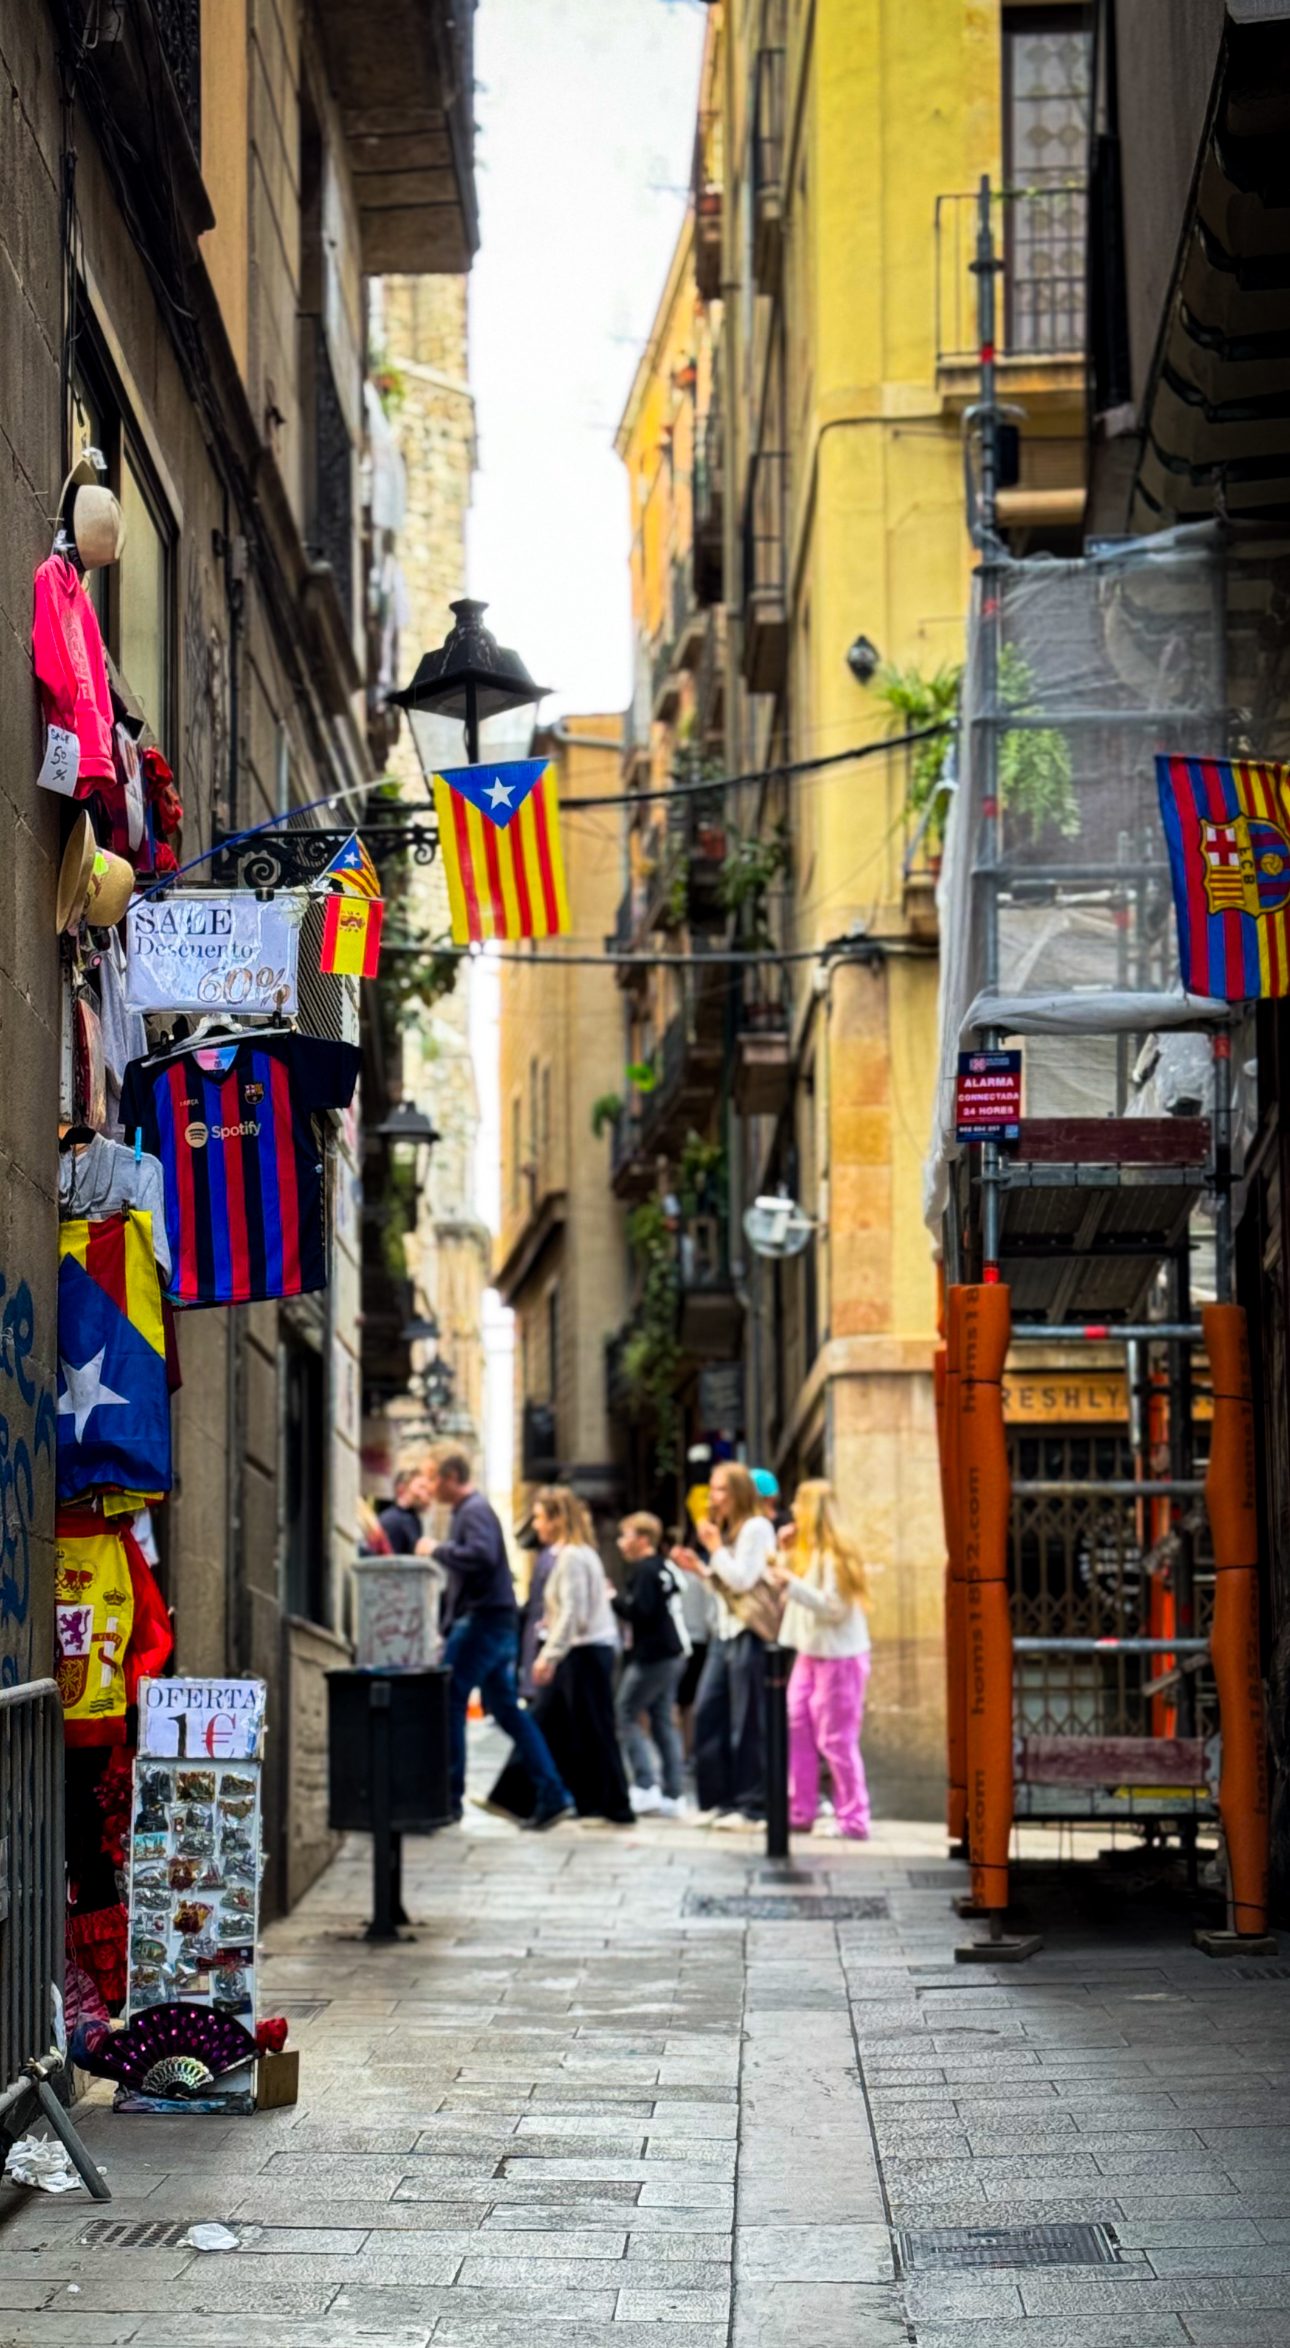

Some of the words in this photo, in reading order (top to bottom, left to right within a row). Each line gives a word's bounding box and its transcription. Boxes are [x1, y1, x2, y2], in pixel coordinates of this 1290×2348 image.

[50, 745, 68, 766] 50
[52, 769, 68, 781] %
[135, 907, 232, 935] SALE
[134, 936, 253, 959] Descuento
[198, 966, 290, 1006] 60%
[964, 1077, 1014, 1088] ALARMA
[958, 1092, 1019, 1102] CONNECTADA
[963, 1107, 976, 1116] 24
[979, 1105, 1014, 1115] HORES
[211, 1121, 261, 1140] Spotify
[1001, 1386, 1120, 1410] RESHLY
[146, 1686, 257, 1709] OFERTA
